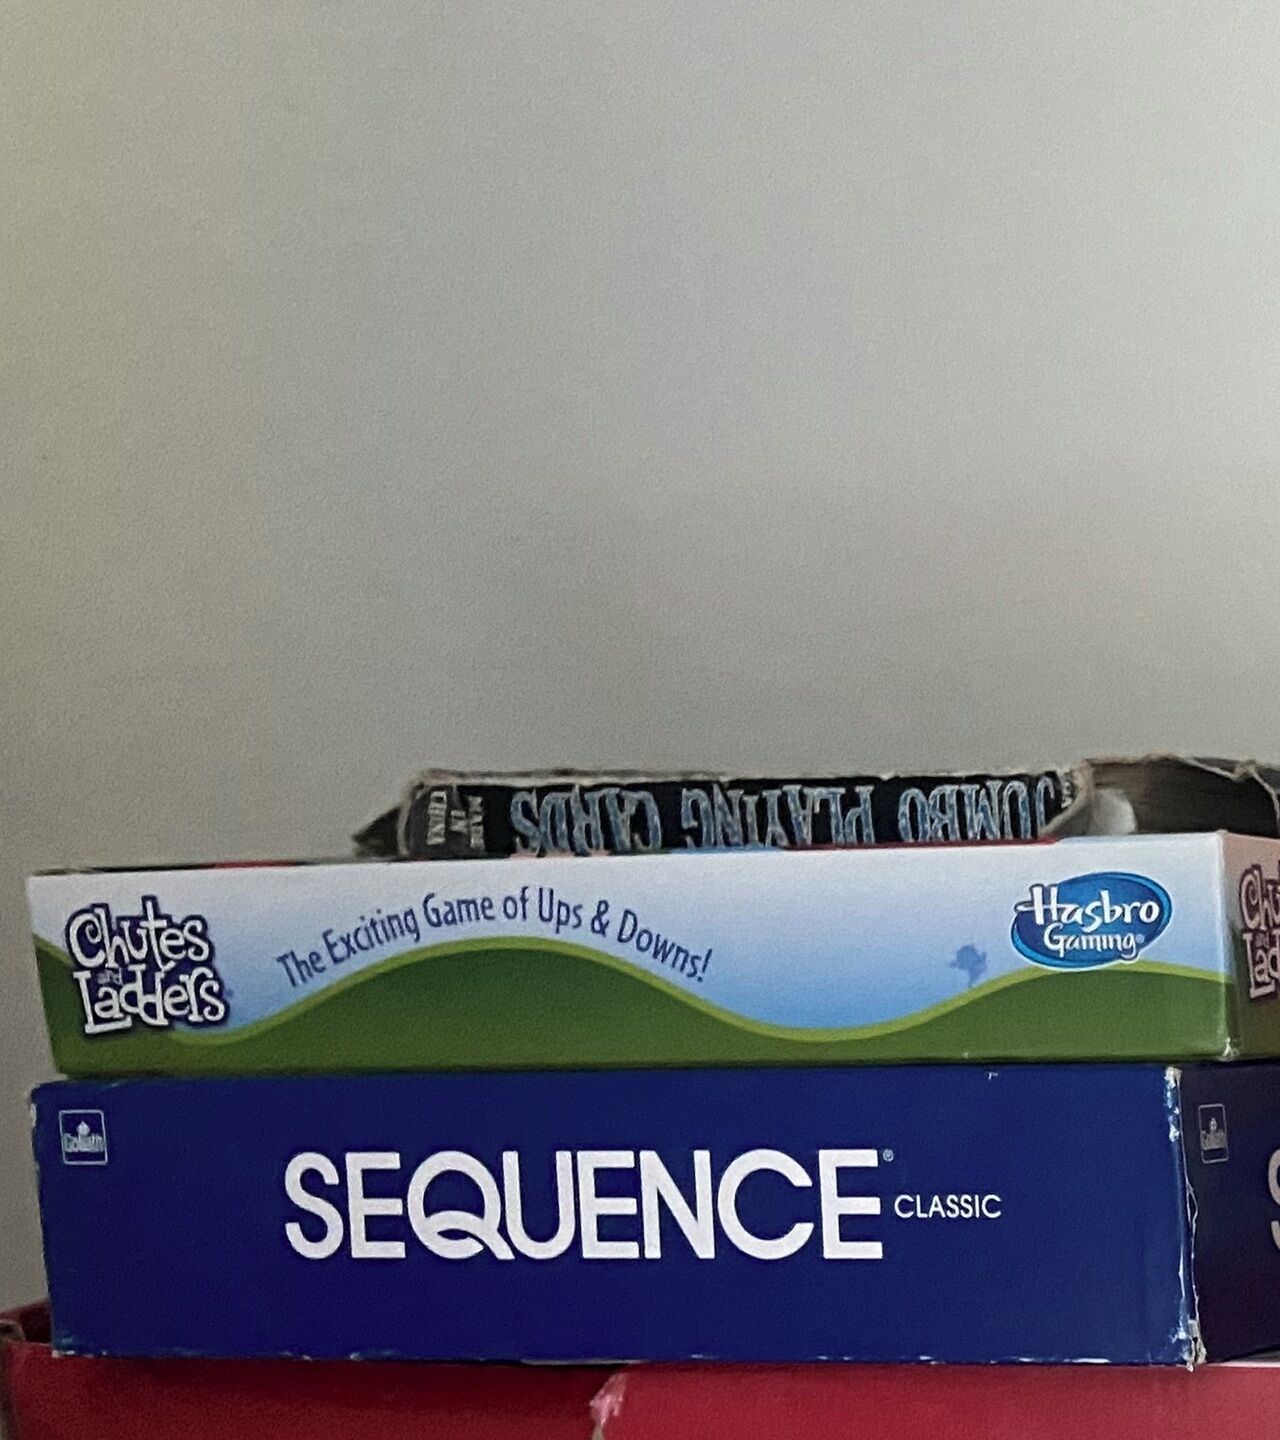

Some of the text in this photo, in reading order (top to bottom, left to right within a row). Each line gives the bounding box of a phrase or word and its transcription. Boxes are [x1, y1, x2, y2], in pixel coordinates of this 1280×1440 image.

[509, 783, 662, 857] CARDS
[680, 781, 876, 849] PLAYING
[897, 771, 1055, 843] JUMBO
[68, 899, 210, 972] Chutes
[276, 886, 714, 989] The Exciting Game of Ups & Downs!
[1016, 885, 1161, 933] Hasbro
[1043, 922, 1137, 960] Gaming
[72, 963, 227, 1034] Ladders
[284, 1147, 1002, 1260] SEQUENCE CLASSIC
